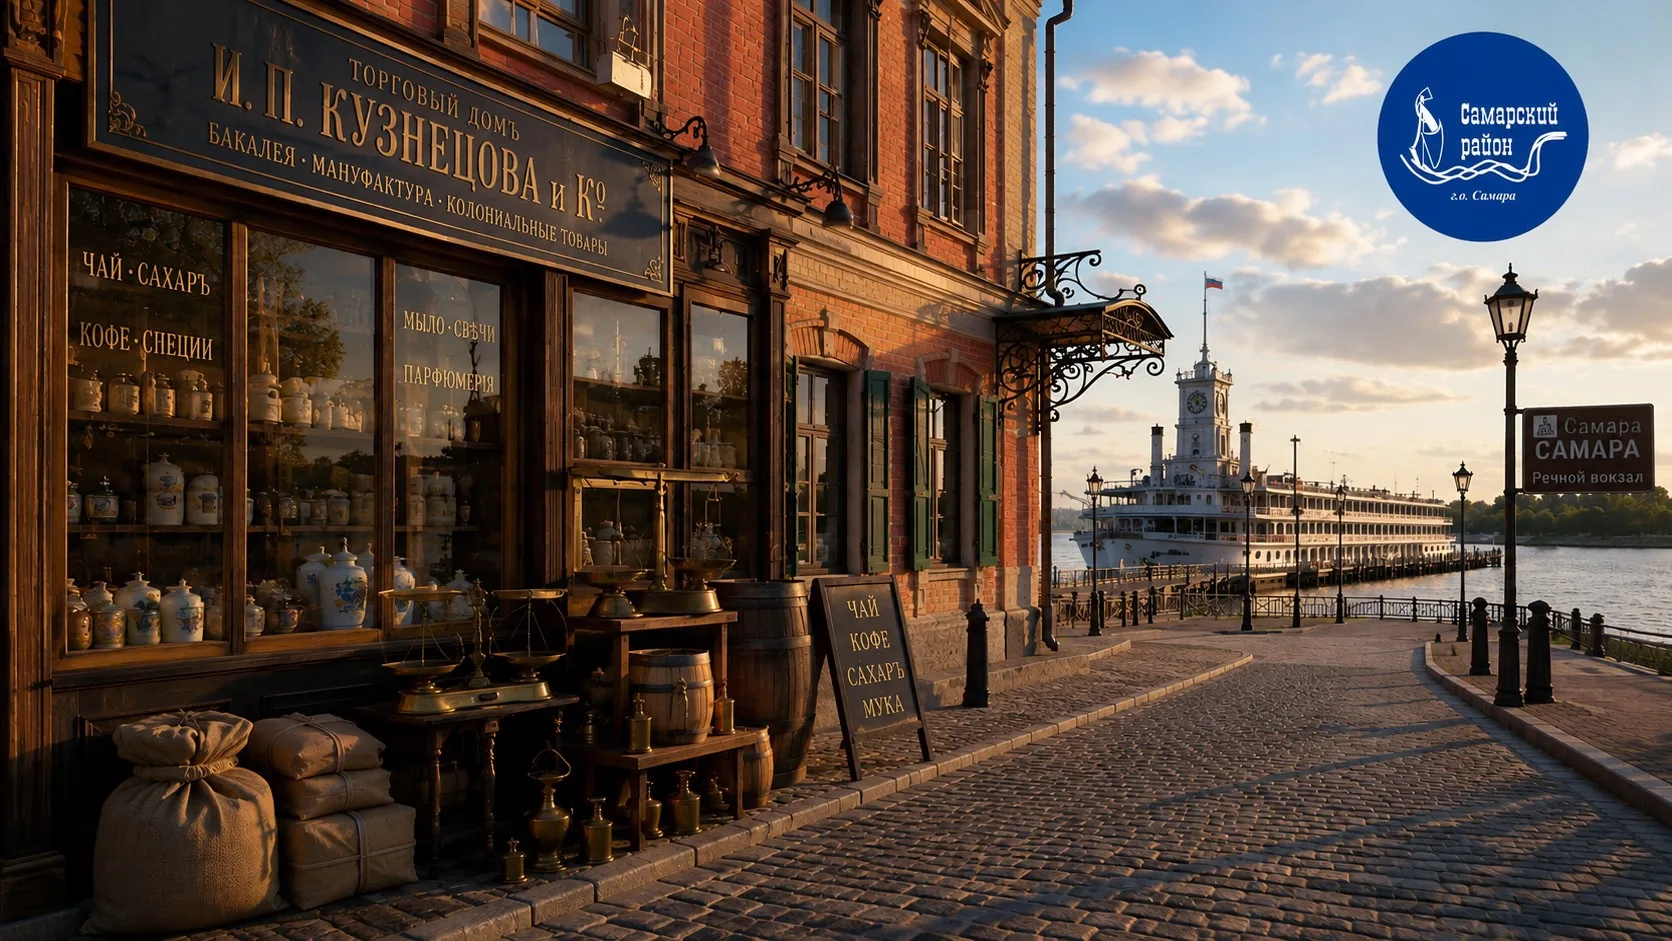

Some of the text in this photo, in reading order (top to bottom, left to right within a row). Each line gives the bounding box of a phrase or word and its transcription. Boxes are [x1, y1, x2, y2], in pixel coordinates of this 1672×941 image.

[348, 57, 520, 141] ТОРГОВЫЙ ДОМЪ
[210, 42, 253, 111] И.
[263, 60, 304, 128] П.
[320, 81, 542, 205] КУЗНЕЦОВА
[549, 180, 566, 212] и
[208, 121, 609, 257] БАКАЛЕЯ МАНУФАКТУРА КОЛОНИАЛЬНЫЕ ТОВАРЫ
[82, 251, 211, 296] ЧАЙ САХАРЪ
[403, 310, 445, 335] МЫЛО
[80, 321, 131, 351] КОФЕ
[1564, 416, 1642, 436] Самара
[1535, 438, 1641, 460] САМАРА
[1532, 470, 1643, 484] Речной вокзал
[847, 595, 880, 619] ЧАЙ
[849, 630, 891, 652] КОФЕ
[847, 661, 905, 687] САХАРЪ
[862, 694, 905, 719] МУКА
